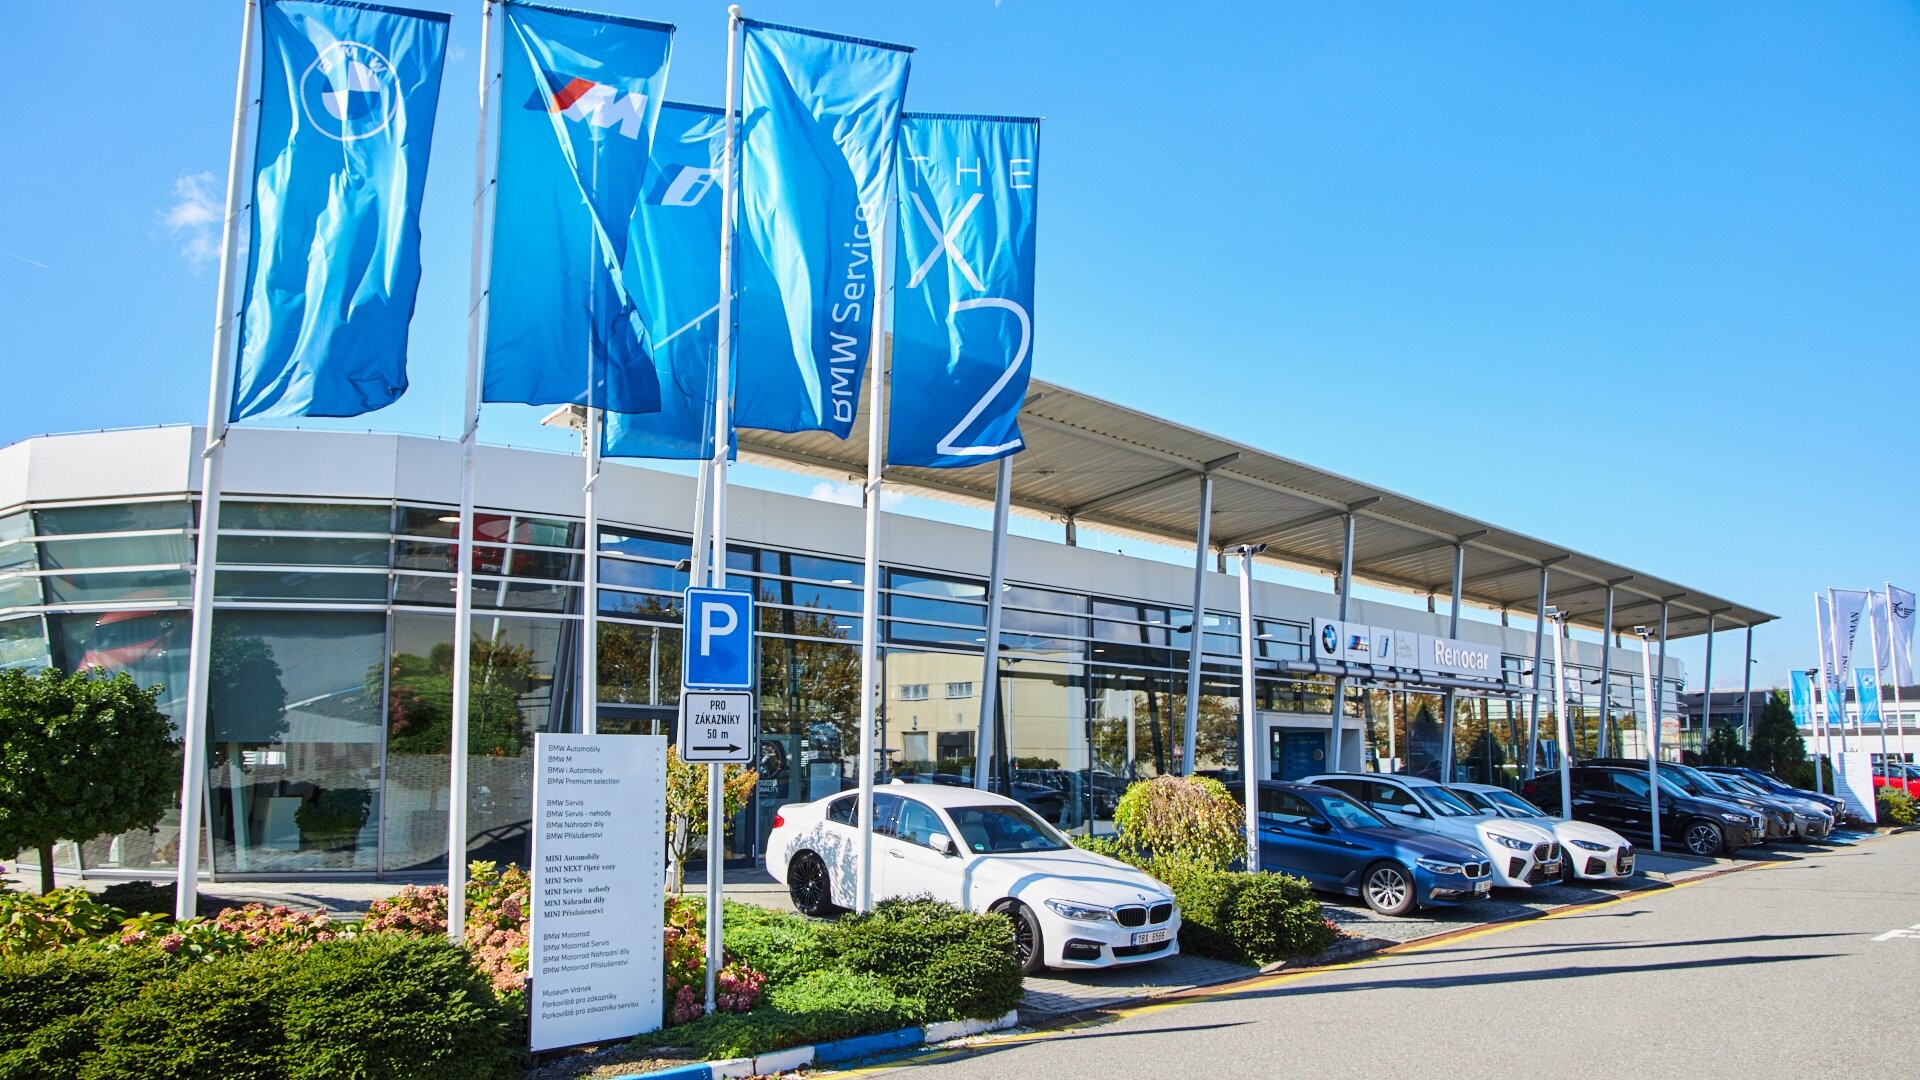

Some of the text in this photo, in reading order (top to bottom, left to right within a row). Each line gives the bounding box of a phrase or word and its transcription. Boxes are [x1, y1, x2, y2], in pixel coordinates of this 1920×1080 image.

[905, 155, 1032, 189] THE
[829, 330, 858, 423] BMW
[700, 601, 739, 657] P
[1433, 639, 1489, 670] Renocar
[710, 700, 726, 711] PRO
[694, 711, 741, 725] ZÁKAZNÍKY
[707, 729, 729, 739] 50 m
[548, 744, 601, 753] BMW Automobily
[548, 755, 565, 763] BMW
[547, 766, 565, 774] BMW
[569, 767, 603, 775] Automobily
[547, 777, 565, 785] BMW
[546, 799, 584, 807] BMW Servis
[546, 810, 564, 818] BMW
[564, 810, 584, 818] Servis
[589, 809, 612, 817] nehody
[546, 821, 564, 829] BMW
[545, 832, 563, 840] BMW
[545, 853, 600, 862] MINI Automobily
[545, 866, 562, 874] MINI
[583, 864, 600, 873] Ojeté
[544, 876, 583, 885] MINI Servis
[544, 888, 561, 896] MINI
[562, 887, 583, 895] Servis
[588, 884, 611, 893] nehody
[544, 899, 561, 907] MINI
[543, 910, 561, 918] MINI
[543, 930, 590, 941] BMW Motorrad
[543, 939, 610, 952] BMW Motorrad Servis
[543, 955, 560, 963] BMW
[561, 952, 589, 961] Motorrad
[542, 966, 560, 975] BMW
[561, 963, 589, 973] Motorrad
[542, 987, 569, 997] Museum
[542, 997, 574, 1009] Parkoviště
[575, 997, 586, 1005] pro
[541, 1008, 574, 1020] Parkoviště
[575, 1008, 586, 1016] pro
[617, 1001, 639, 1010] servisu
